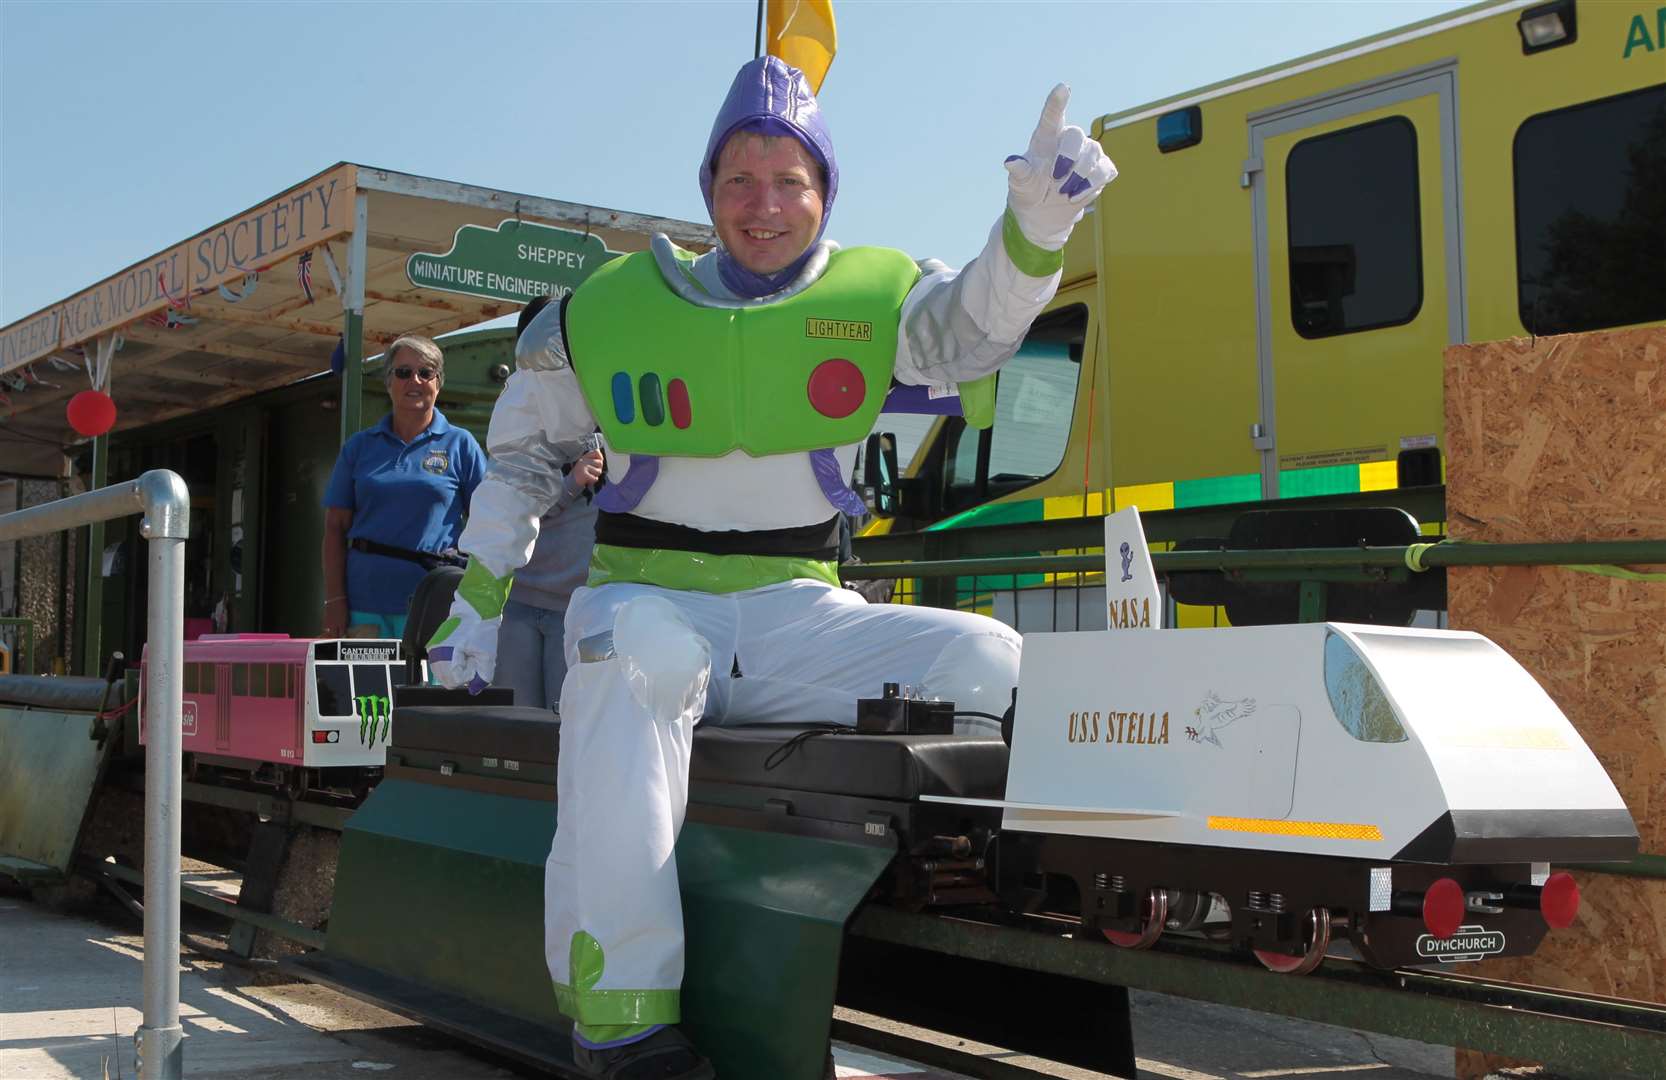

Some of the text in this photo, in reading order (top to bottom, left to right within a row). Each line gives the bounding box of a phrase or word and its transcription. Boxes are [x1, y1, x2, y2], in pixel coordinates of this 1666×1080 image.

[90, 291, 104, 329] &
[107, 252, 184, 322] MODEL
[195, 178, 339, 285] SOCIETY
[518, 243, 585, 269] SHEPPEY
[414, 259, 484, 288] MINIATURE
[807, 319, 870, 339] LIGHTYEAR
[1108, 597, 1151, 629] NASA
[341, 647, 396, 655] CANTERBURY
[1067, 710, 1170, 745] USS STELLA
[1426, 937, 1496, 952] DYMCHURCH
